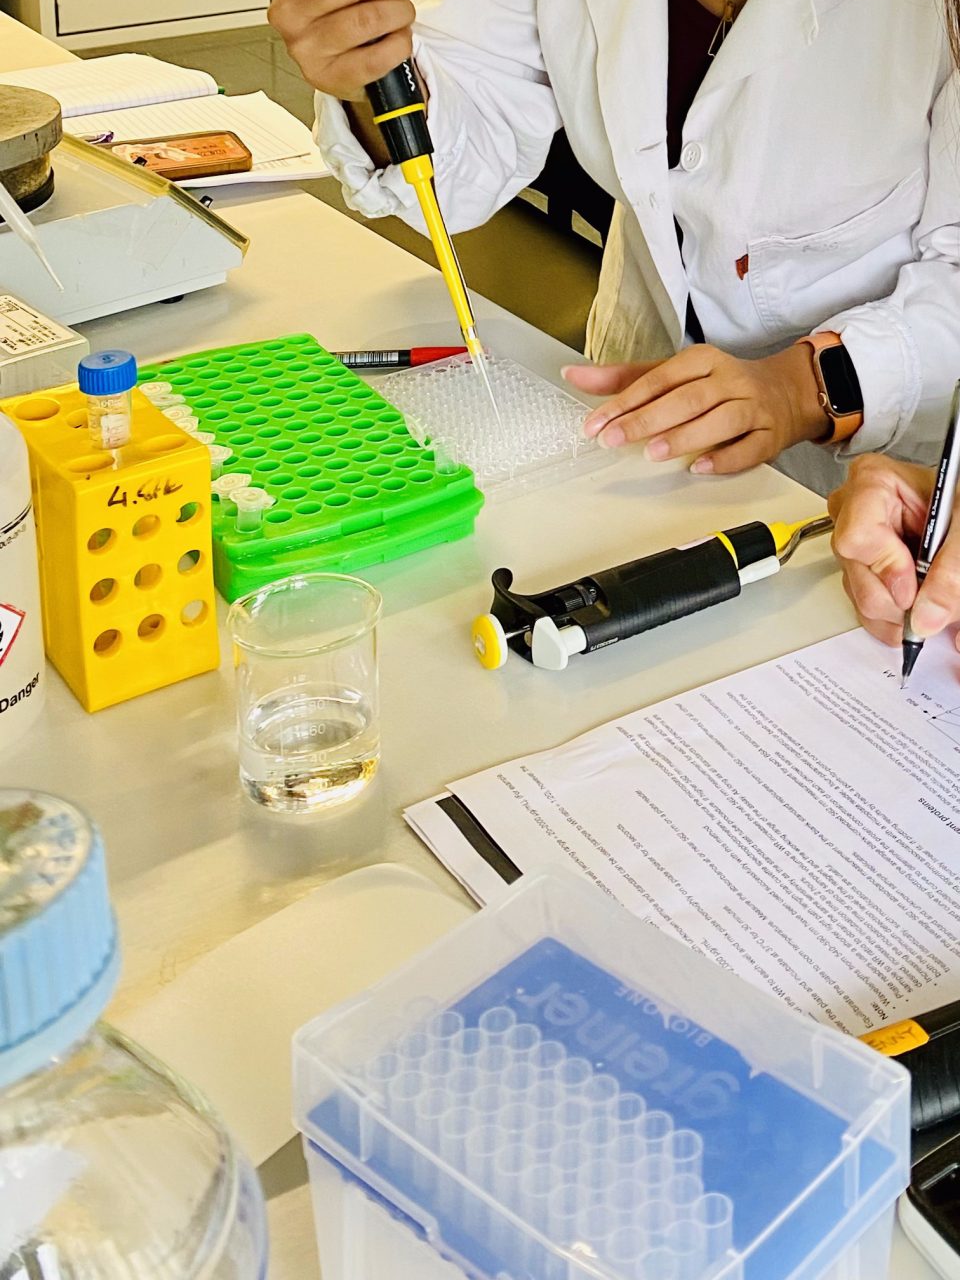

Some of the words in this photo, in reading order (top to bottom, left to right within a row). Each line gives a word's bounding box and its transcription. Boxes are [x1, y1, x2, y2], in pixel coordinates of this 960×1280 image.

[0, 672, 40, 715] Danger
[309, 723, 327, 736] 60
[918, 797, 950, 822] proteins
[855, 971, 892, 1007] Wavelengths
[887, 982, 904, 999] Plate
[891, 972, 914, 994] sample
[843, 996, 874, 1029] Equilibrate
[872, 1003, 889, 1021] Note:
[516, 982, 742, 1118] greiner
